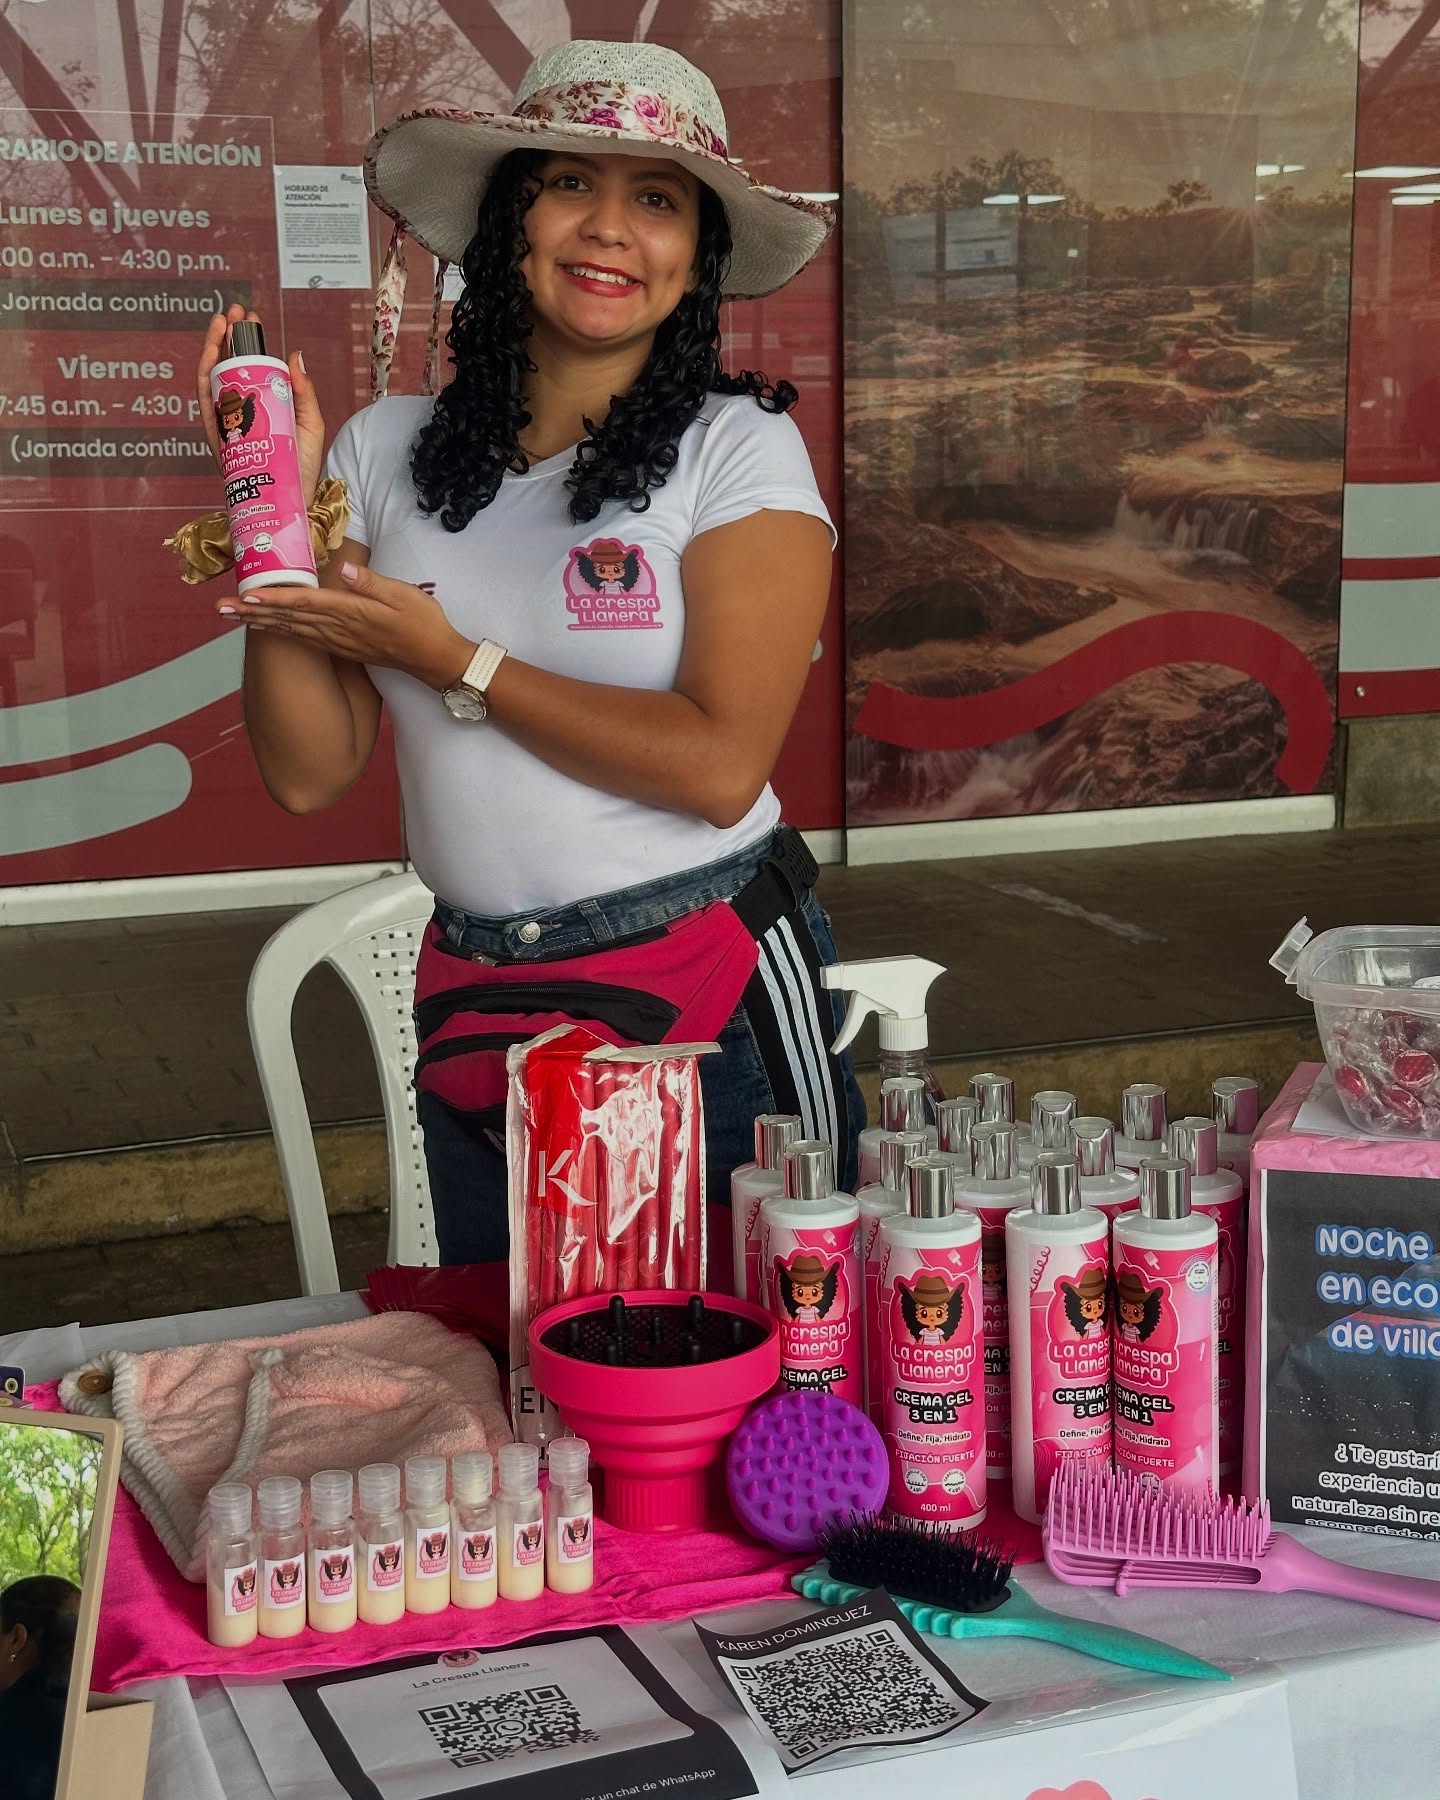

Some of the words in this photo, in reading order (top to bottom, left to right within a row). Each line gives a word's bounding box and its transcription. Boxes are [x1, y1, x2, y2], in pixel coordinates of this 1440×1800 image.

[84, 140, 119, 163] DE
[123, 137, 262, 167] ATENCIÓN
[320, 185, 329, 193] DE
[0, 203, 83, 226] Lunes
[88, 207, 108, 226] a
[112, 201, 211, 234] jueves
[39, 251, 95, 269] a.m.
[120, 248, 172, 270] 4:30
[177, 252, 231, 276] p.m.
[0, 292, 104, 314] Jornada
[109, 289, 224, 315] continua)
[57, 354, 174, 380] Viernes
[0, 395, 46, 416] 7:45
[52, 398, 107, 417] a.m.
[131, 395, 183, 417] 4:30
[11, 434, 117, 462] (Jornada
[225, 439, 270, 460] crespa
[249, 474, 273, 486] GEL
[235, 490, 249, 502] EN
[250, 488, 259, 497] 1
[251, 519, 281, 530] FUERTE
[570, 597, 592, 610] La
[595, 597, 657, 613] crespa
[582, 610, 650, 623] Llanera
[537, 1149, 599, 1207] K
[1319, 1228, 1430, 1261] Noche
[1320, 1275, 1363, 1302] en
[789, 1321, 847, 1342] crespa
[1331, 1321, 1375, 1350] de
[894, 1343, 910, 1361] La
[913, 1344, 972, 1365] crespa
[1053, 1345, 1074, 1358] La
[1118, 1344, 1173, 1367] crespa
[901, 1362, 965, 1380] Llanera
[1064, 1353, 1110, 1374] Llaner
[781, 1368, 819, 1383] REMA
[821, 1367, 847, 1381] GEL
[895, 1390, 943, 1407] CREMA
[946, 1391, 973, 1406] GEL
[1055, 1387, 1104, 1402] CREMA
[1141, 1396, 1172, 1410] GEL
[911, 1409, 920, 1420] 3
[923, 1410, 943, 1421] EN
[946, 1409, 956, 1421] 1
[1076, 1405, 1086, 1416] 3
[1088, 1402, 1104, 1415] EN
[1117, 1402, 1123, 1413] 3
[1124, 1407, 1139, 1420] EN
[1142, 1411, 1151, 1423] 1
[898, 1429, 924, 1443] Define,
[925, 1434, 942, 1444] Fija,
[944, 1431, 971, 1442] Hidrata
[1060, 1430, 1089, 1438] Define,
[1139, 1435, 1169, 1446] Hidrata
[895, 1448, 940, 1464] FIJACIÓN
[942, 1449, 975, 1463] FUERTE
[1055, 1446, 1103, 1459] FIJACIÓN
[1137, 1455, 1175, 1468] FUERTE
[1320, 1472, 1423, 1496] experiencia
[920, 1503, 938, 1512] 400
[939, 1502, 951, 1512] ml
[1293, 1496, 1387, 1519] naturaleza
[1390, 1506, 1416, 1522] sin
[1305, 1519, 1423, 1539] acompañado
[715, 1638, 771, 1653] KAREN
[772, 1604, 872, 1644] DOMINGUEZ
[412, 1681, 430, 1689] La
[432, 1671, 480, 1684] Crespa
[481, 1661, 530, 1675] Llanera
[615, 1786, 641, 1798] chat
[642, 1781, 657, 1791] de
[658, 1768, 716, 1788] WhatsApp
